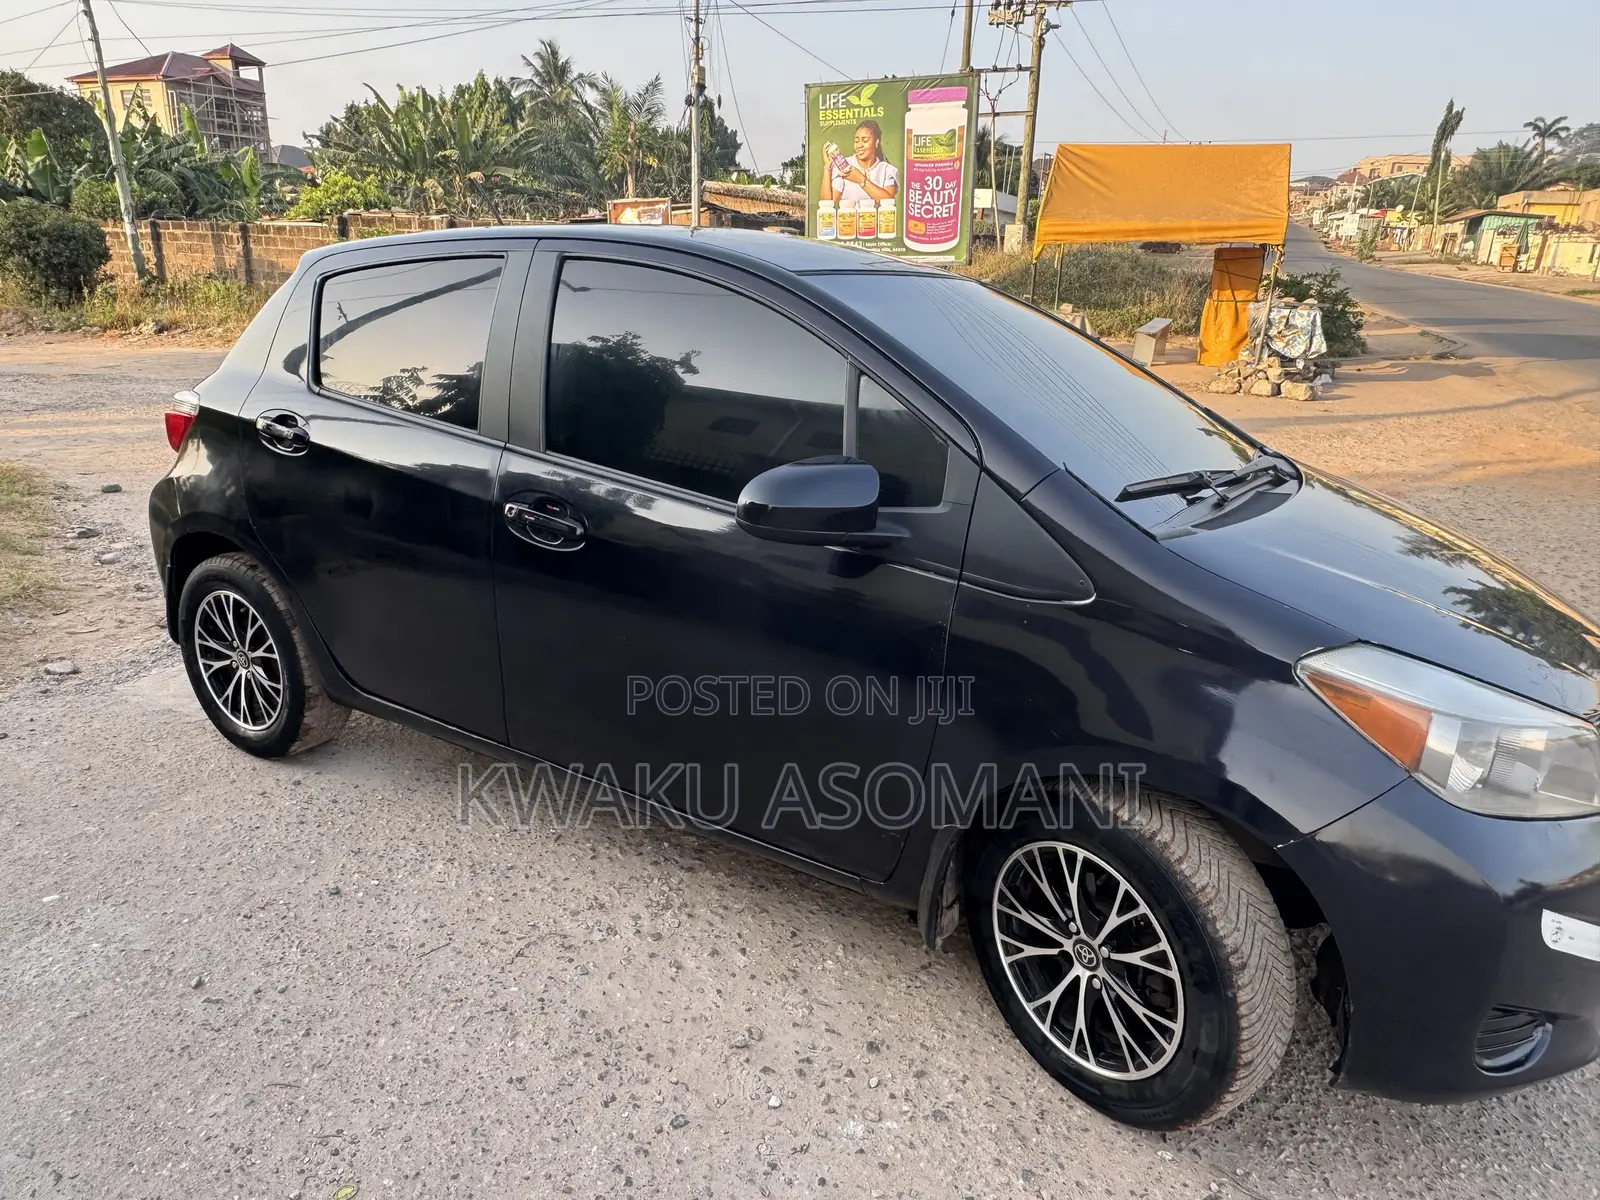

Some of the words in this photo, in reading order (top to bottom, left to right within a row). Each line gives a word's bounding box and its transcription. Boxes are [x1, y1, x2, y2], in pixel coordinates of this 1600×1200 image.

[819, 93, 847, 109] LIFE
[819, 107, 884, 120] ESSENTIALS
[819, 119, 857, 127] SUPPLEMENTS
[914, 136, 932, 147] LIFE
[911, 181, 921, 190] THE
[924, 175, 942, 191] 30
[945, 180, 957, 189] DAY
[909, 188, 957, 205] BEAUTY
[909, 202, 957, 219] SECRET
